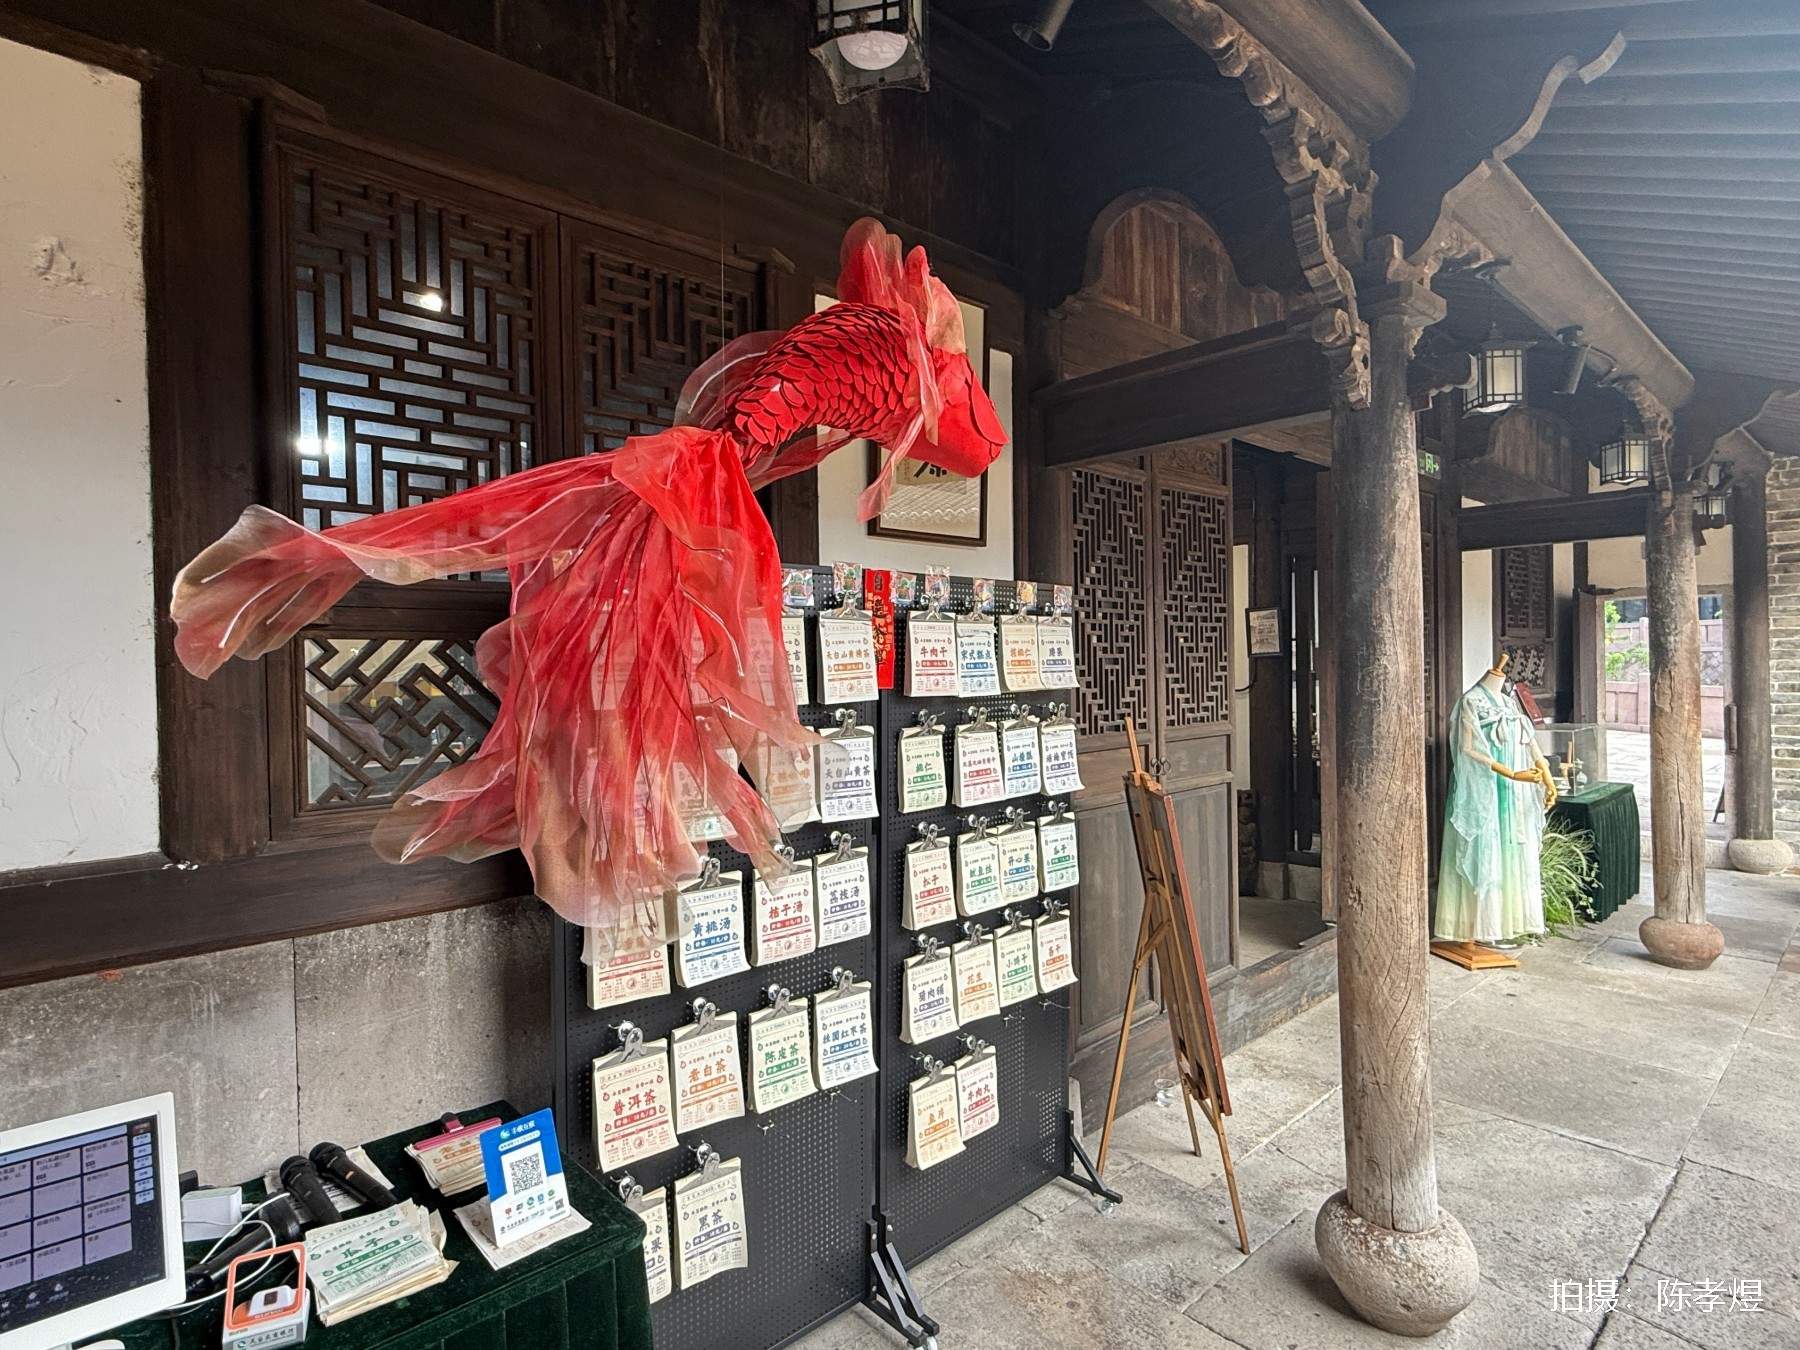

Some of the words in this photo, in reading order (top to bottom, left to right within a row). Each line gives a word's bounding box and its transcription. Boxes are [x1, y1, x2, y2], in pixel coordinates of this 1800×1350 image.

[920, 646, 948, 658] 牛肉干
[960, 649, 993, 661] 宋式糕点
[825, 765, 871, 779] 天台山黄茶
[1008, 853, 1031, 866] 开心果
[829, 886, 860, 904] 荔枝汤
[693, 917, 731, 938] 黄桃汤
[967, 973, 983, 985] 花生
[764, 1042, 799, 1065] 陈皮茶
[688, 1058, 727, 1083] 老白茶
[613, 1088, 656, 1116] 普洱茶
